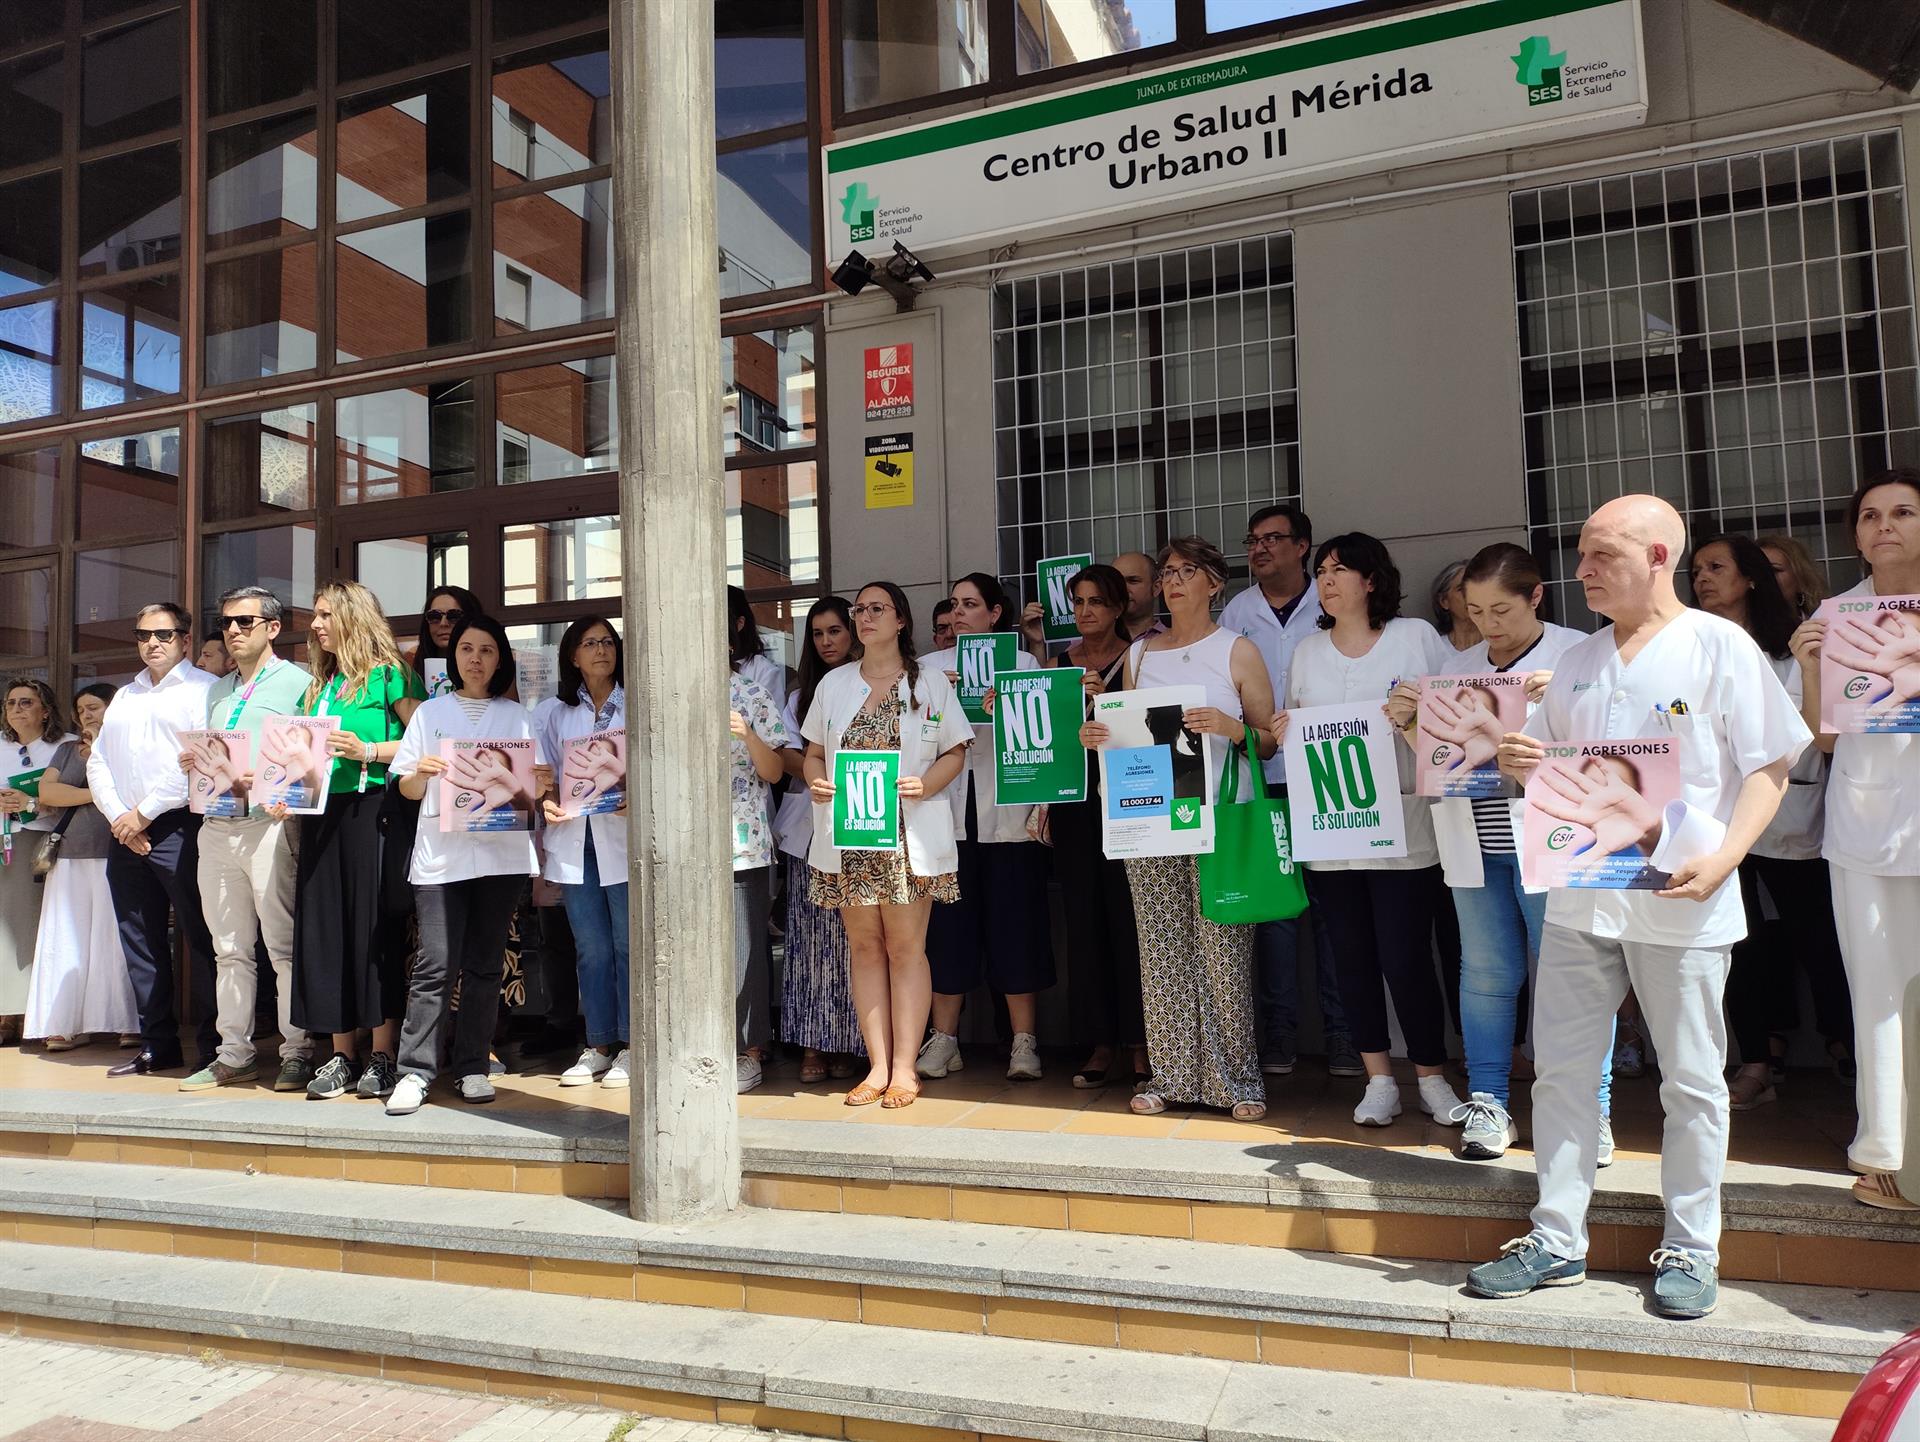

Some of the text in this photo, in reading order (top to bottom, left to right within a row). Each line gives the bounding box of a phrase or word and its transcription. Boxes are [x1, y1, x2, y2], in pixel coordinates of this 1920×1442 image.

[1564, 60, 1608, 76] Servicio
[1136, 65, 1248, 100] JUNTA DE EXTREMADURA
[1566, 69, 1627, 88] Extremeño
[1529, 85, 1561, 102] SES
[1567, 82, 1612, 99] de Salud
[983, 68, 1433, 182] Centro de Salud Mérida
[1108, 128, 1287, 190] Urbano II
[879, 206, 910, 217] Servicio
[879, 214, 923, 228] Extremeño
[851, 226, 874, 240] SES
[879, 225, 912, 238] de Salud
[866, 364, 911, 379] SEGUREX
[867, 395, 911, 409] ALARMA
[866, 410, 881, 419] 924
[881, 437, 896, 445] ZONA
[869, 444, 909, 454] VIDEOVIGILADA
[1046, 563, 1081, 577] LA AGRESIÓN
[1838, 602, 1874, 613] STOP
[1051, 614, 1076, 626] ES SOLUC
[962, 637, 996, 649] LA AGRESIÓN
[962, 647, 994, 688] NO
[1001, 676, 1052, 693] LA AGRESIÓN
[1430, 677, 1522, 689] STOP AGRESIONES
[1849, 682, 1873, 692] CSIF
[961, 687, 986, 697] ES SOLUC
[1100, 701, 1124, 710] SATSE
[290, 719, 330, 729] AGRESIONES
[1001, 688, 1053, 752] NO
[206, 732, 246, 740] AGRESIONES
[1303, 718, 1369, 742] LA AGRESIÓN
[1003, 748, 1054, 765] ES SOLUCIÓN
[1544, 743, 1670, 758] STOP AGRESIONES
[846, 760, 887, 773] LA AGRESIÓN
[1305, 735, 1377, 814] NO
[846, 771, 885, 819] NO
[844, 818, 886, 831] ES SOLUCIÓN
[1312, 809, 1380, 830] ES SOLUCIÓN
[1270, 811, 1295, 875] SATSE
[1370, 839, 1395, 847] SATSE
[1553, 833, 1576, 842] CSIF
